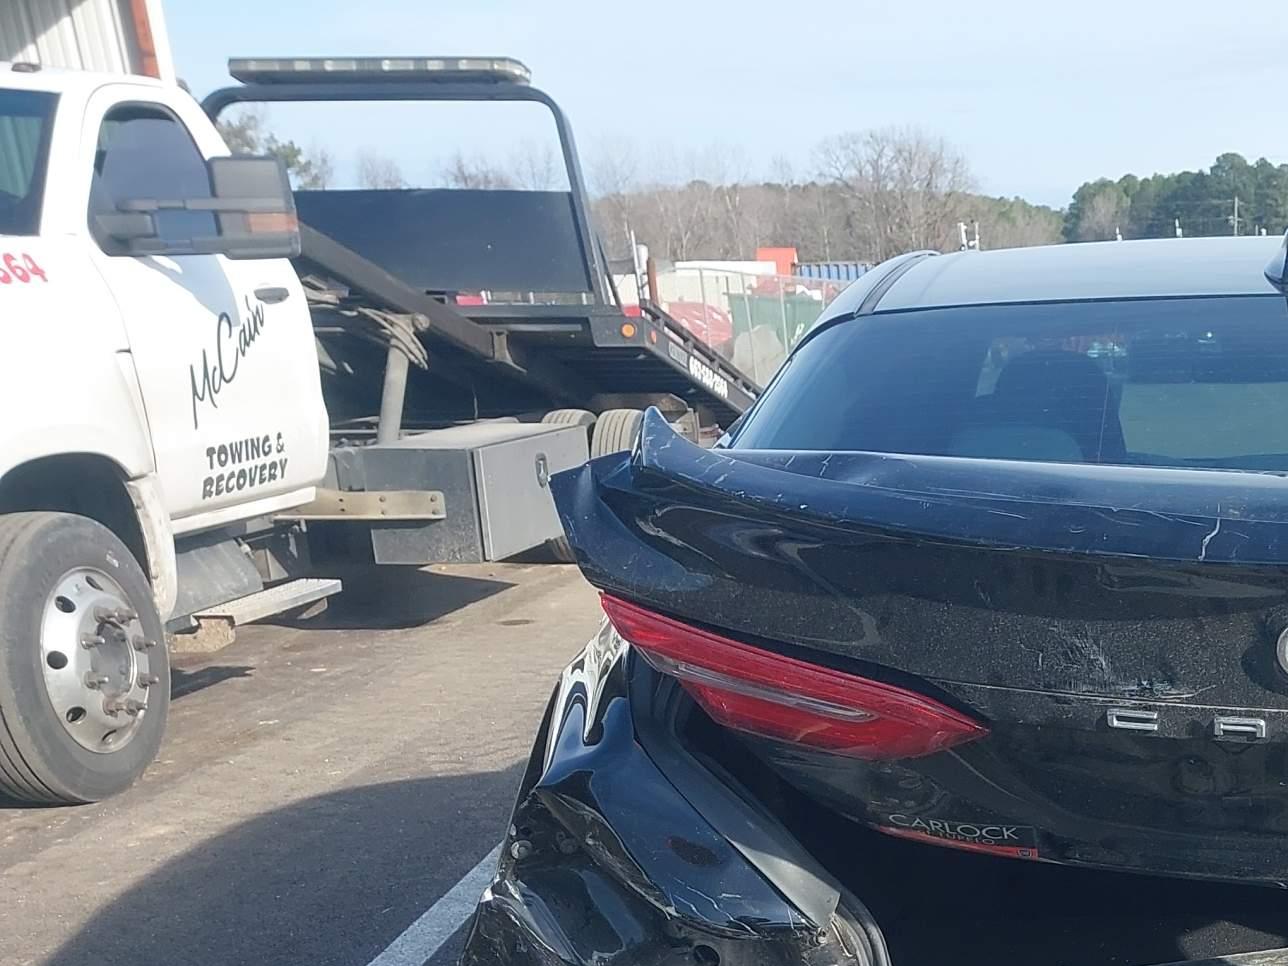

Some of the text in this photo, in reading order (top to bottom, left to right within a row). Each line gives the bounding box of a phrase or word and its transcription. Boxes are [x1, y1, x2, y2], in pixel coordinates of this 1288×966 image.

[190, 294, 264, 430] McCain
[206, 432, 285, 469] TOWING &
[202, 458, 288, 500] RECOVERY
[888, 814, 1019, 840] CARLOCK
